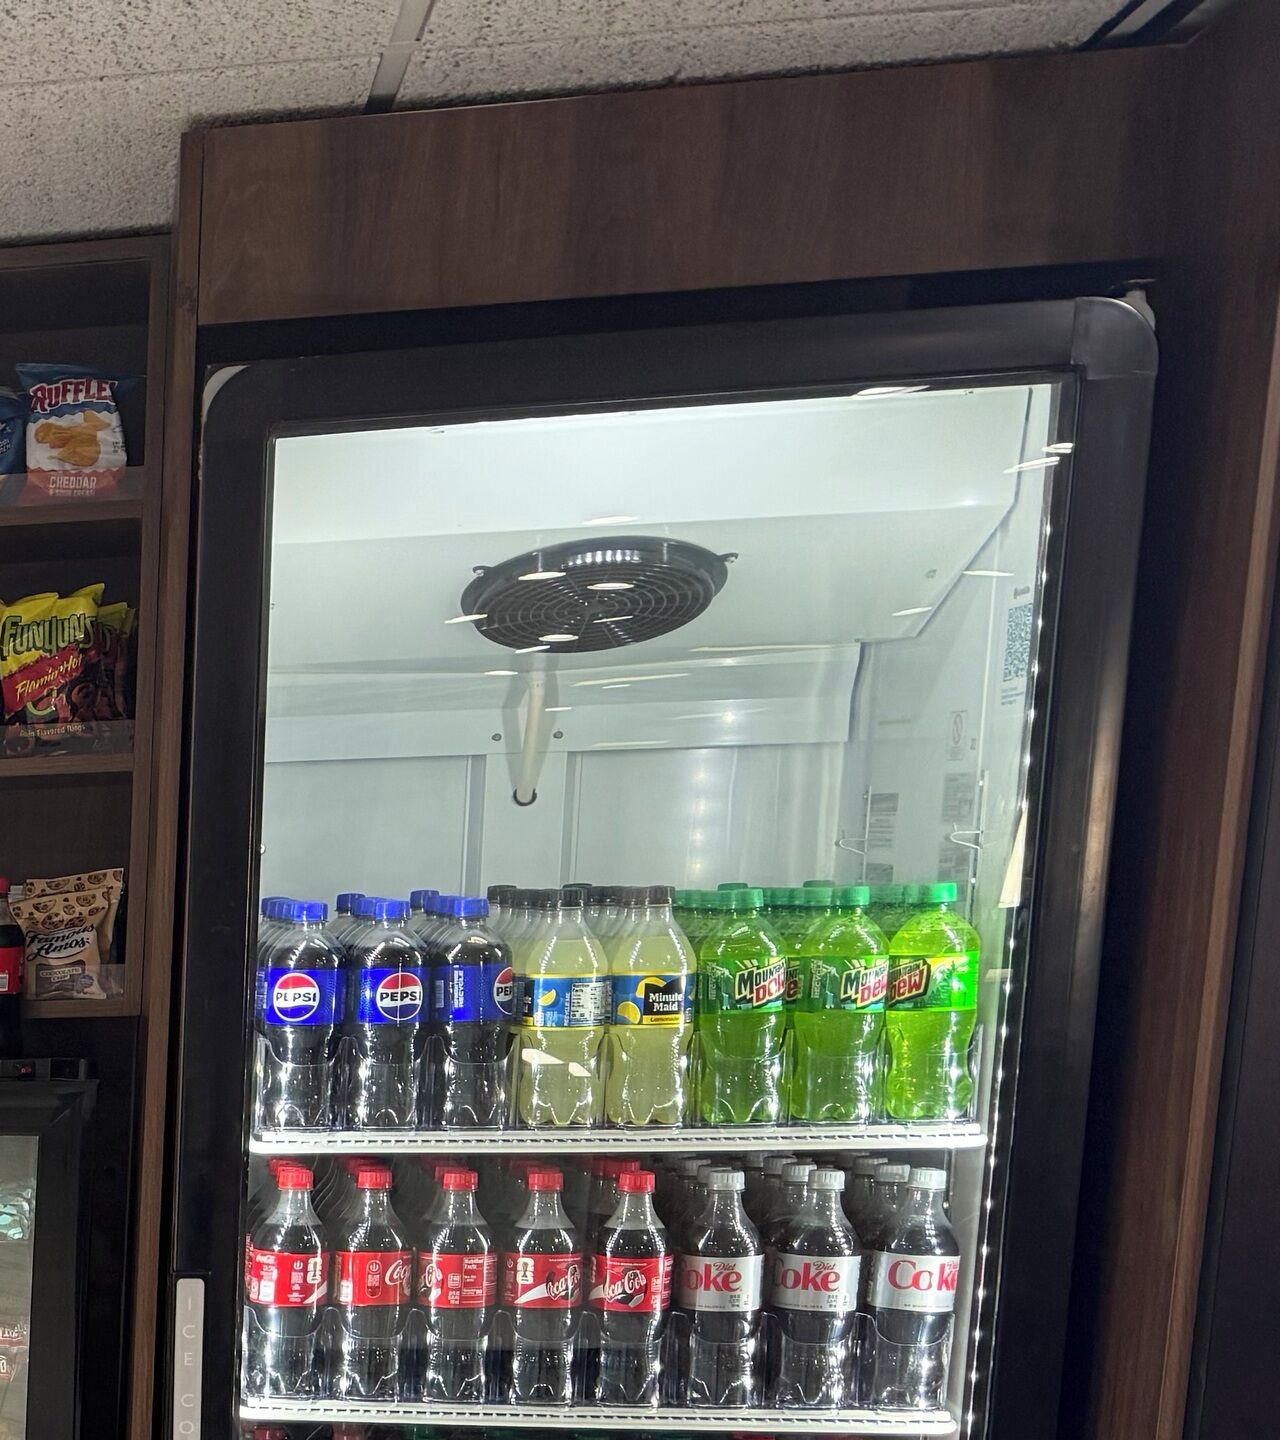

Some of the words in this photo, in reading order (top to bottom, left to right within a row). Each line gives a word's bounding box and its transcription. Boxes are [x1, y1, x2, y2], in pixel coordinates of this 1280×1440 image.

[49, 476, 97, 488] CHEDDAR
[26, 924, 95, 946] Famous
[276, 991, 317, 1002] PEPSI
[380, 991, 421, 1002] PEPSI
[649, 992, 683, 1002] Minute
[653, 1001, 678, 1012] Maid
[687, 1264, 743, 1292] oke
